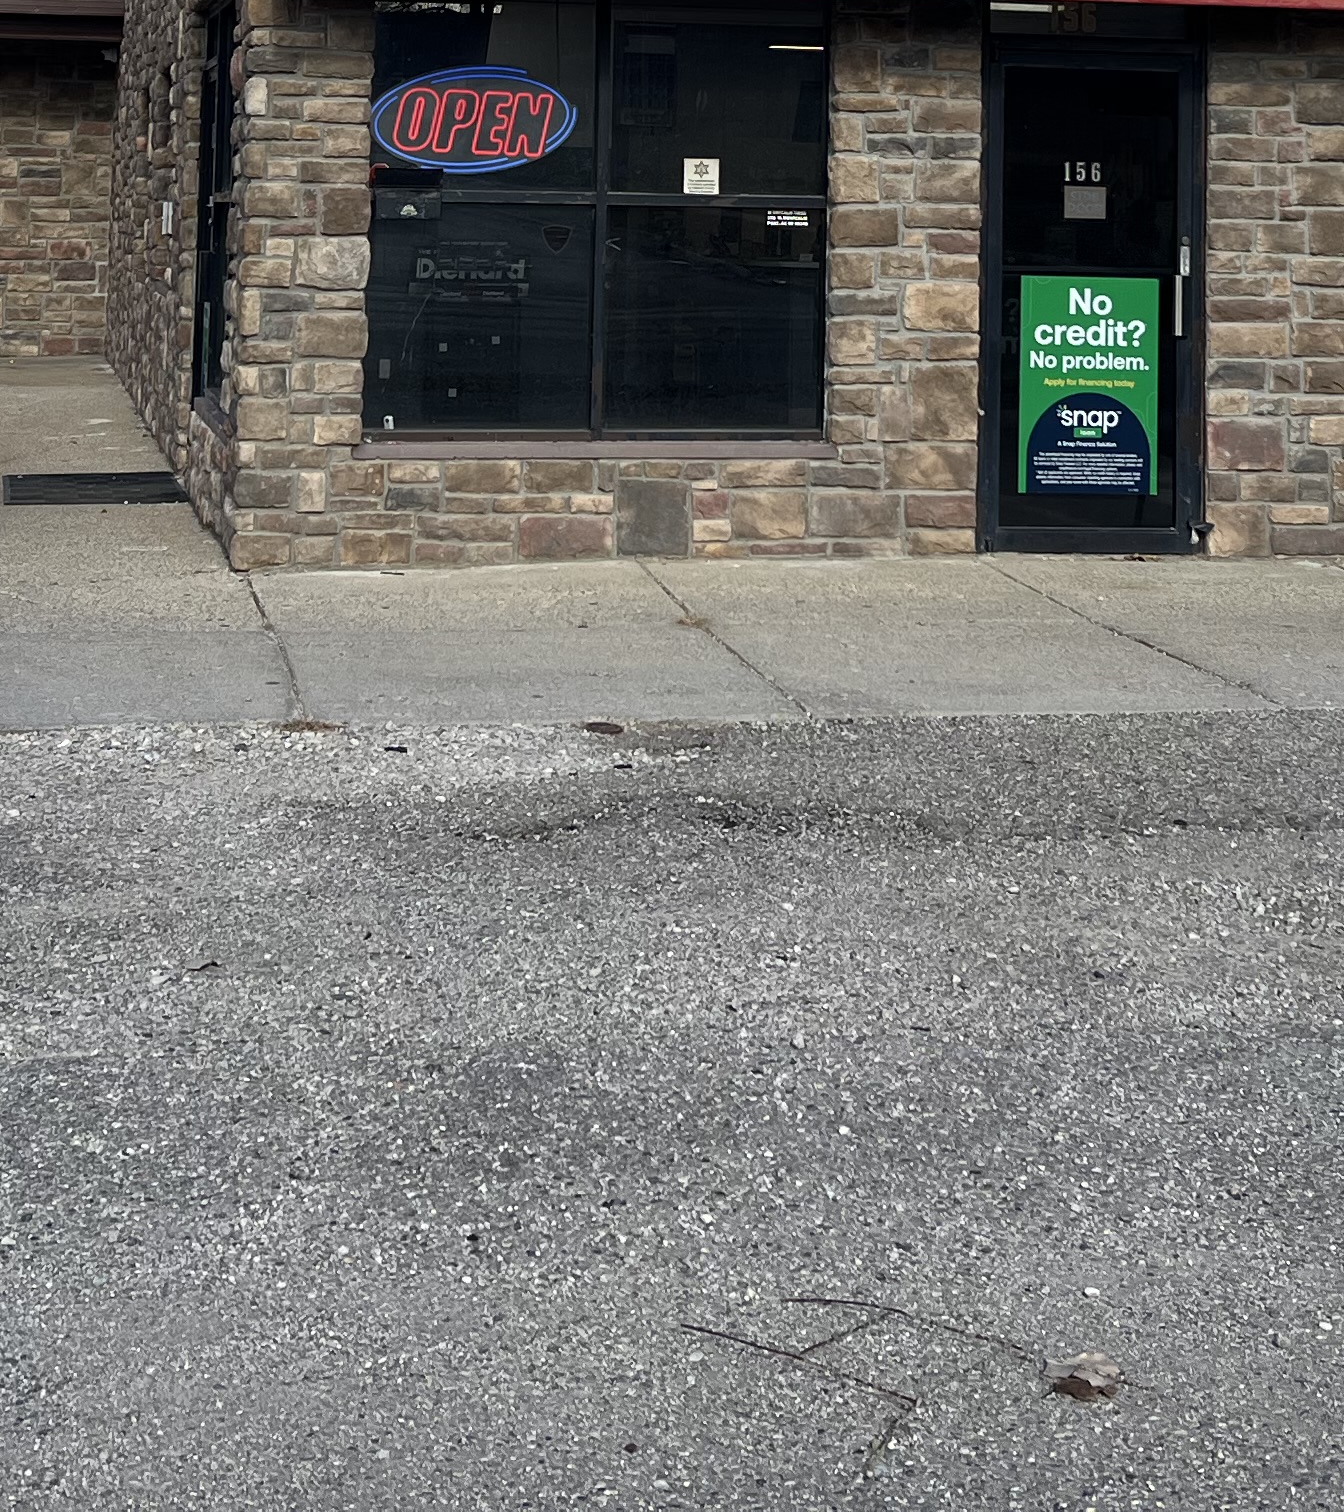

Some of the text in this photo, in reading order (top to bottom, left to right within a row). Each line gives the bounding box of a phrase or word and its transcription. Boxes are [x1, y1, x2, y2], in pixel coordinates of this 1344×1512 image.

[392, 87, 554, 159] OPEN
[1064, 161, 1102, 182] 156
[1068, 287, 1113, 316] No
[1034, 319, 1146, 347] credit?
[1029, 350, 1150, 373] No problem.
[1043, 377, 1136, 389] Apply for financing today
[1060, 409, 1119, 434] snap
